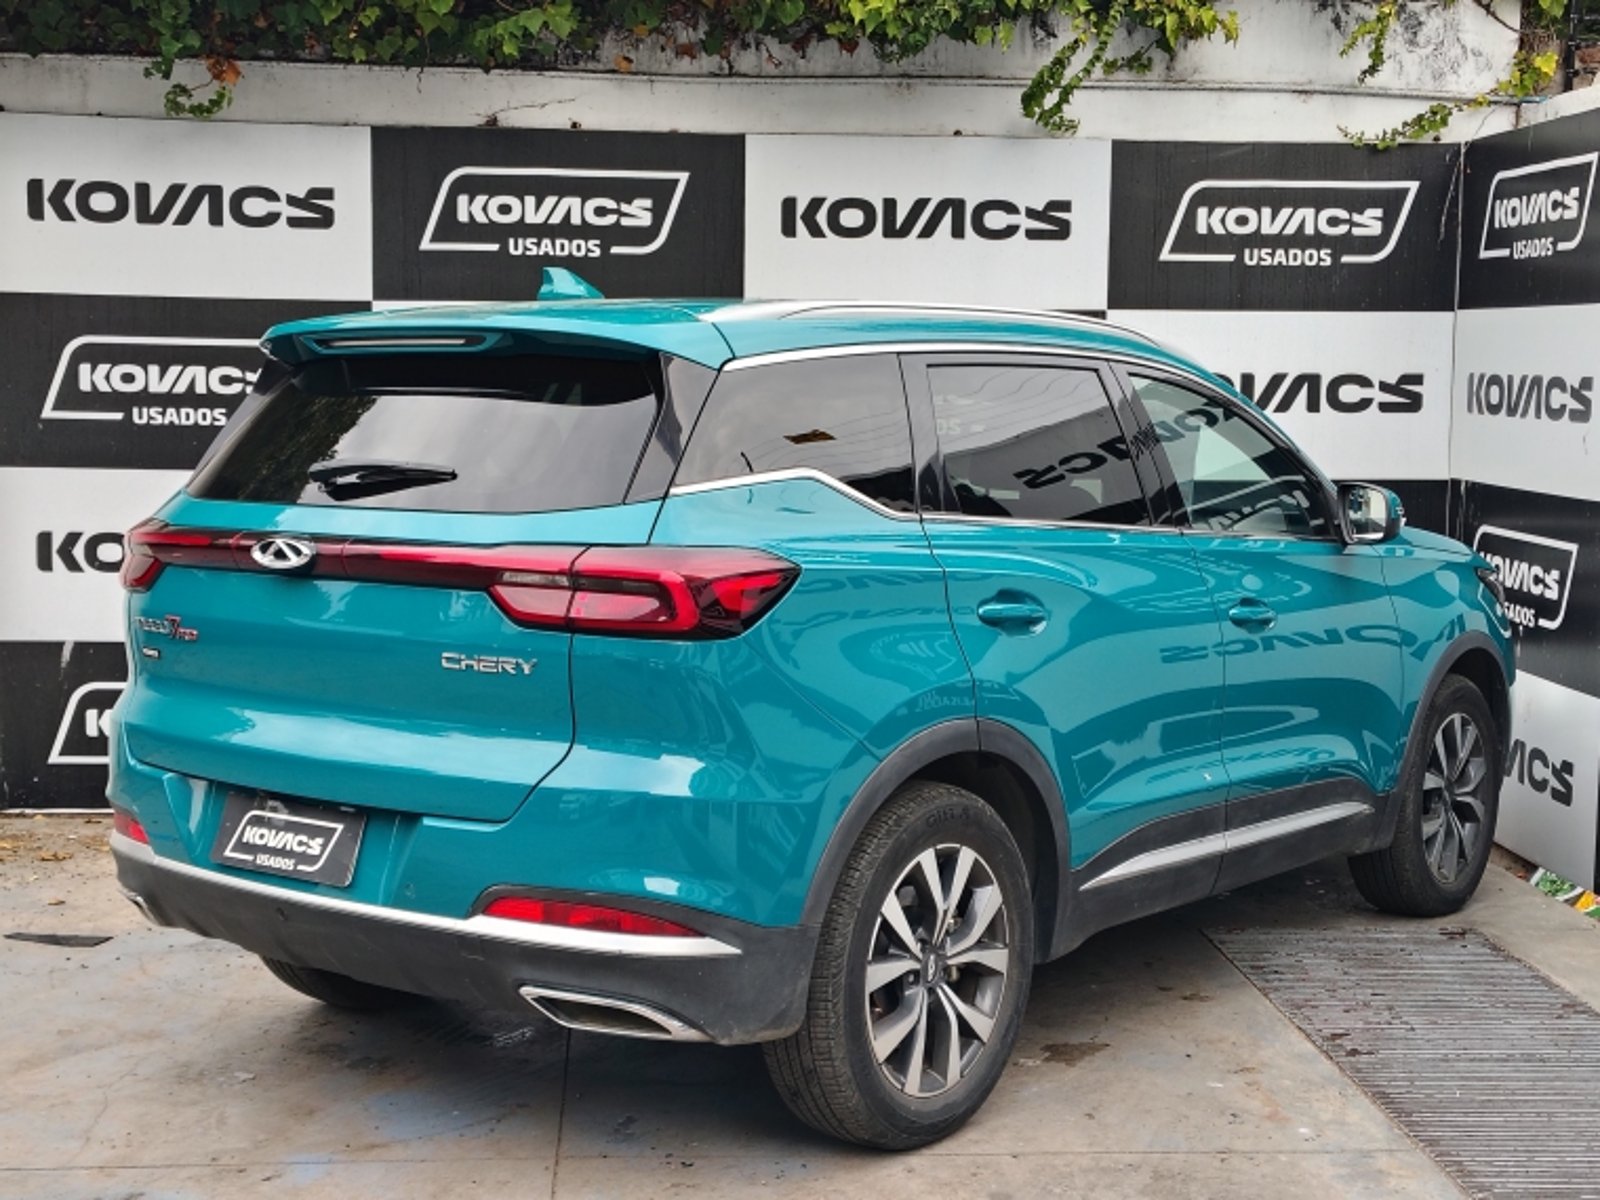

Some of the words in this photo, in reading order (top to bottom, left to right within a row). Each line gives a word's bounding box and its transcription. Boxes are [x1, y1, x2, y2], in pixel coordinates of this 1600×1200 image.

[27, 179, 335, 230] KOVACS
[456, 193, 654, 228] KOVACS
[781, 196, 1072, 241] KOVACS
[1494, 187, 1580, 229] KOVACS
[1195, 205, 1384, 237] KOVACS
[508, 237, 601, 258] USADOS
[1243, 247, 1332, 267] USADOS
[1513, 236, 1554, 260] USADOS
[1214, 373, 1425, 413] VACS
[1467, 373, 1594, 424] KOVACS
[133, 406, 228, 426] USADOS
[441, 652, 538, 675] CHERY
[1505, 738, 1574, 807] ACS
[242, 825, 325, 856] KOVACS
[255, 853, 296, 871] USADOS
